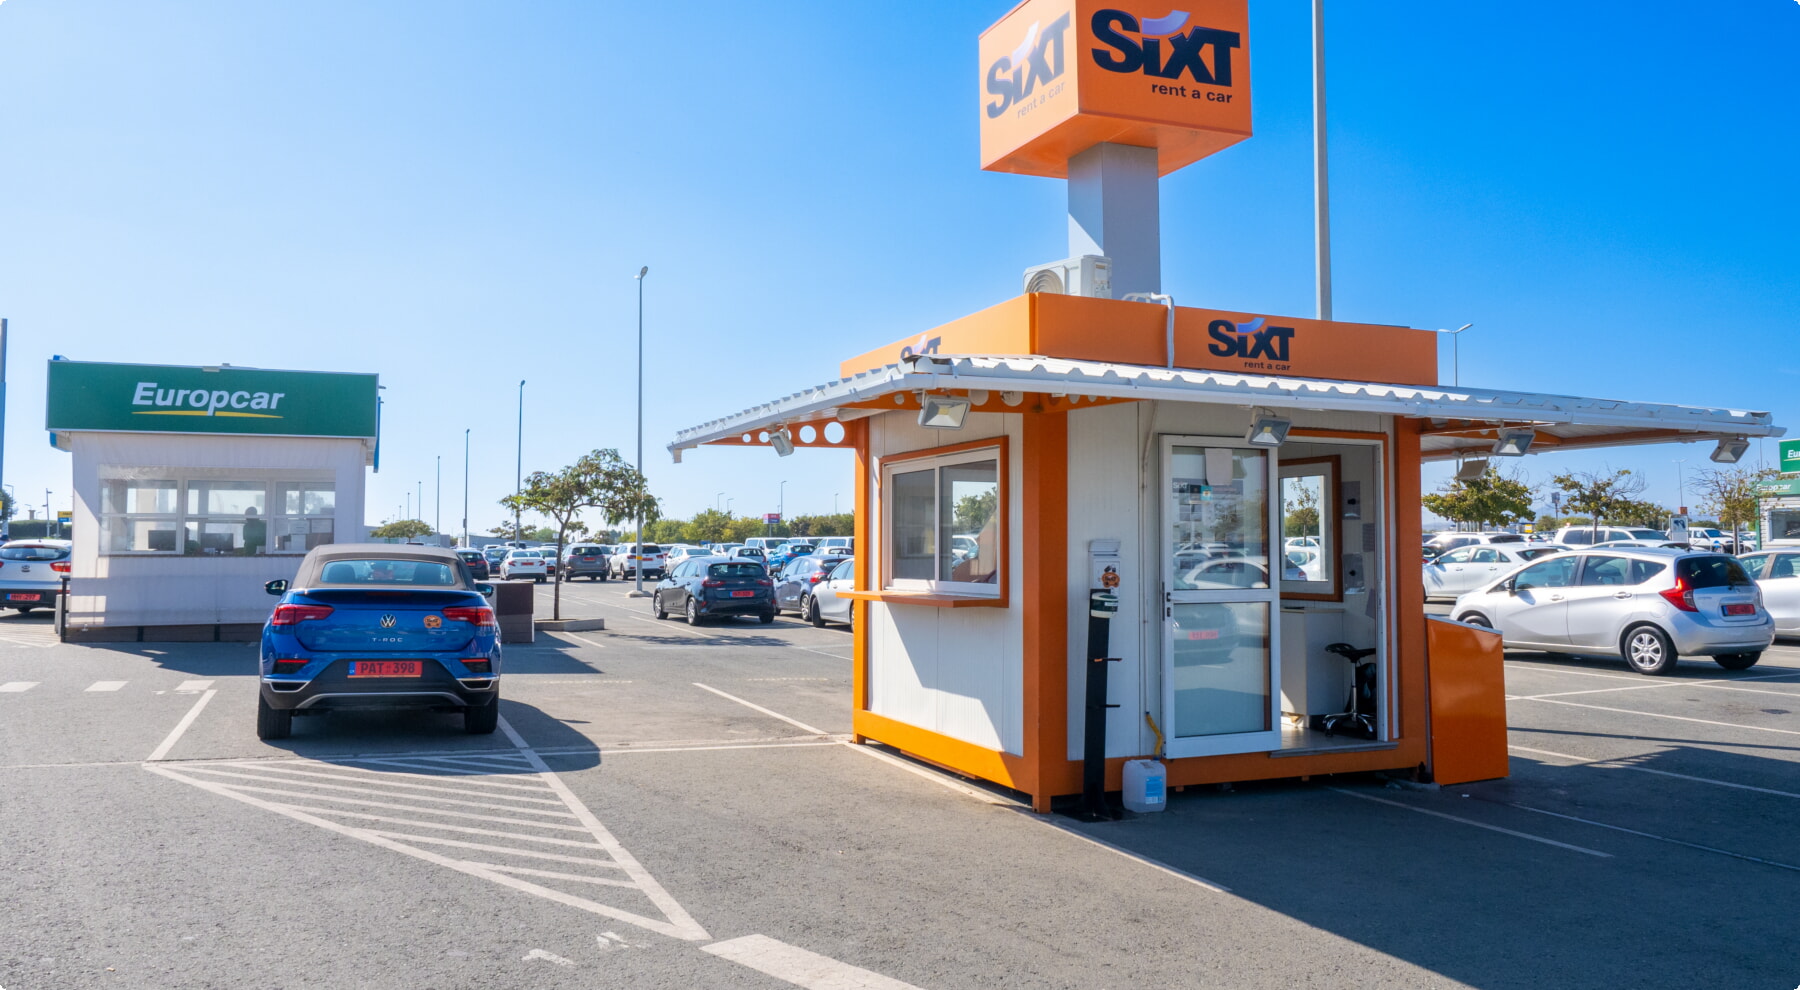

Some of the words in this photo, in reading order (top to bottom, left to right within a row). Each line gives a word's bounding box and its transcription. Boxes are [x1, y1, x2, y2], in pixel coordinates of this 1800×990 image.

[1017, 97, 1038, 119] rent
[1039, 94, 1046, 105] a
[1048, 81, 1066, 99] car
[1151, 83, 1187, 98] rent
[1191, 89, 1201, 99] a
[1206, 91, 1233, 103] car
[1244, 361, 1265, 369] rent
[1266, 362, 1273, 370] a
[1275, 363, 1292, 371] car
[131, 381, 286, 417] Europcar
[360, 662, 384, 674] PAT
[392, 662, 415, 674] 398
